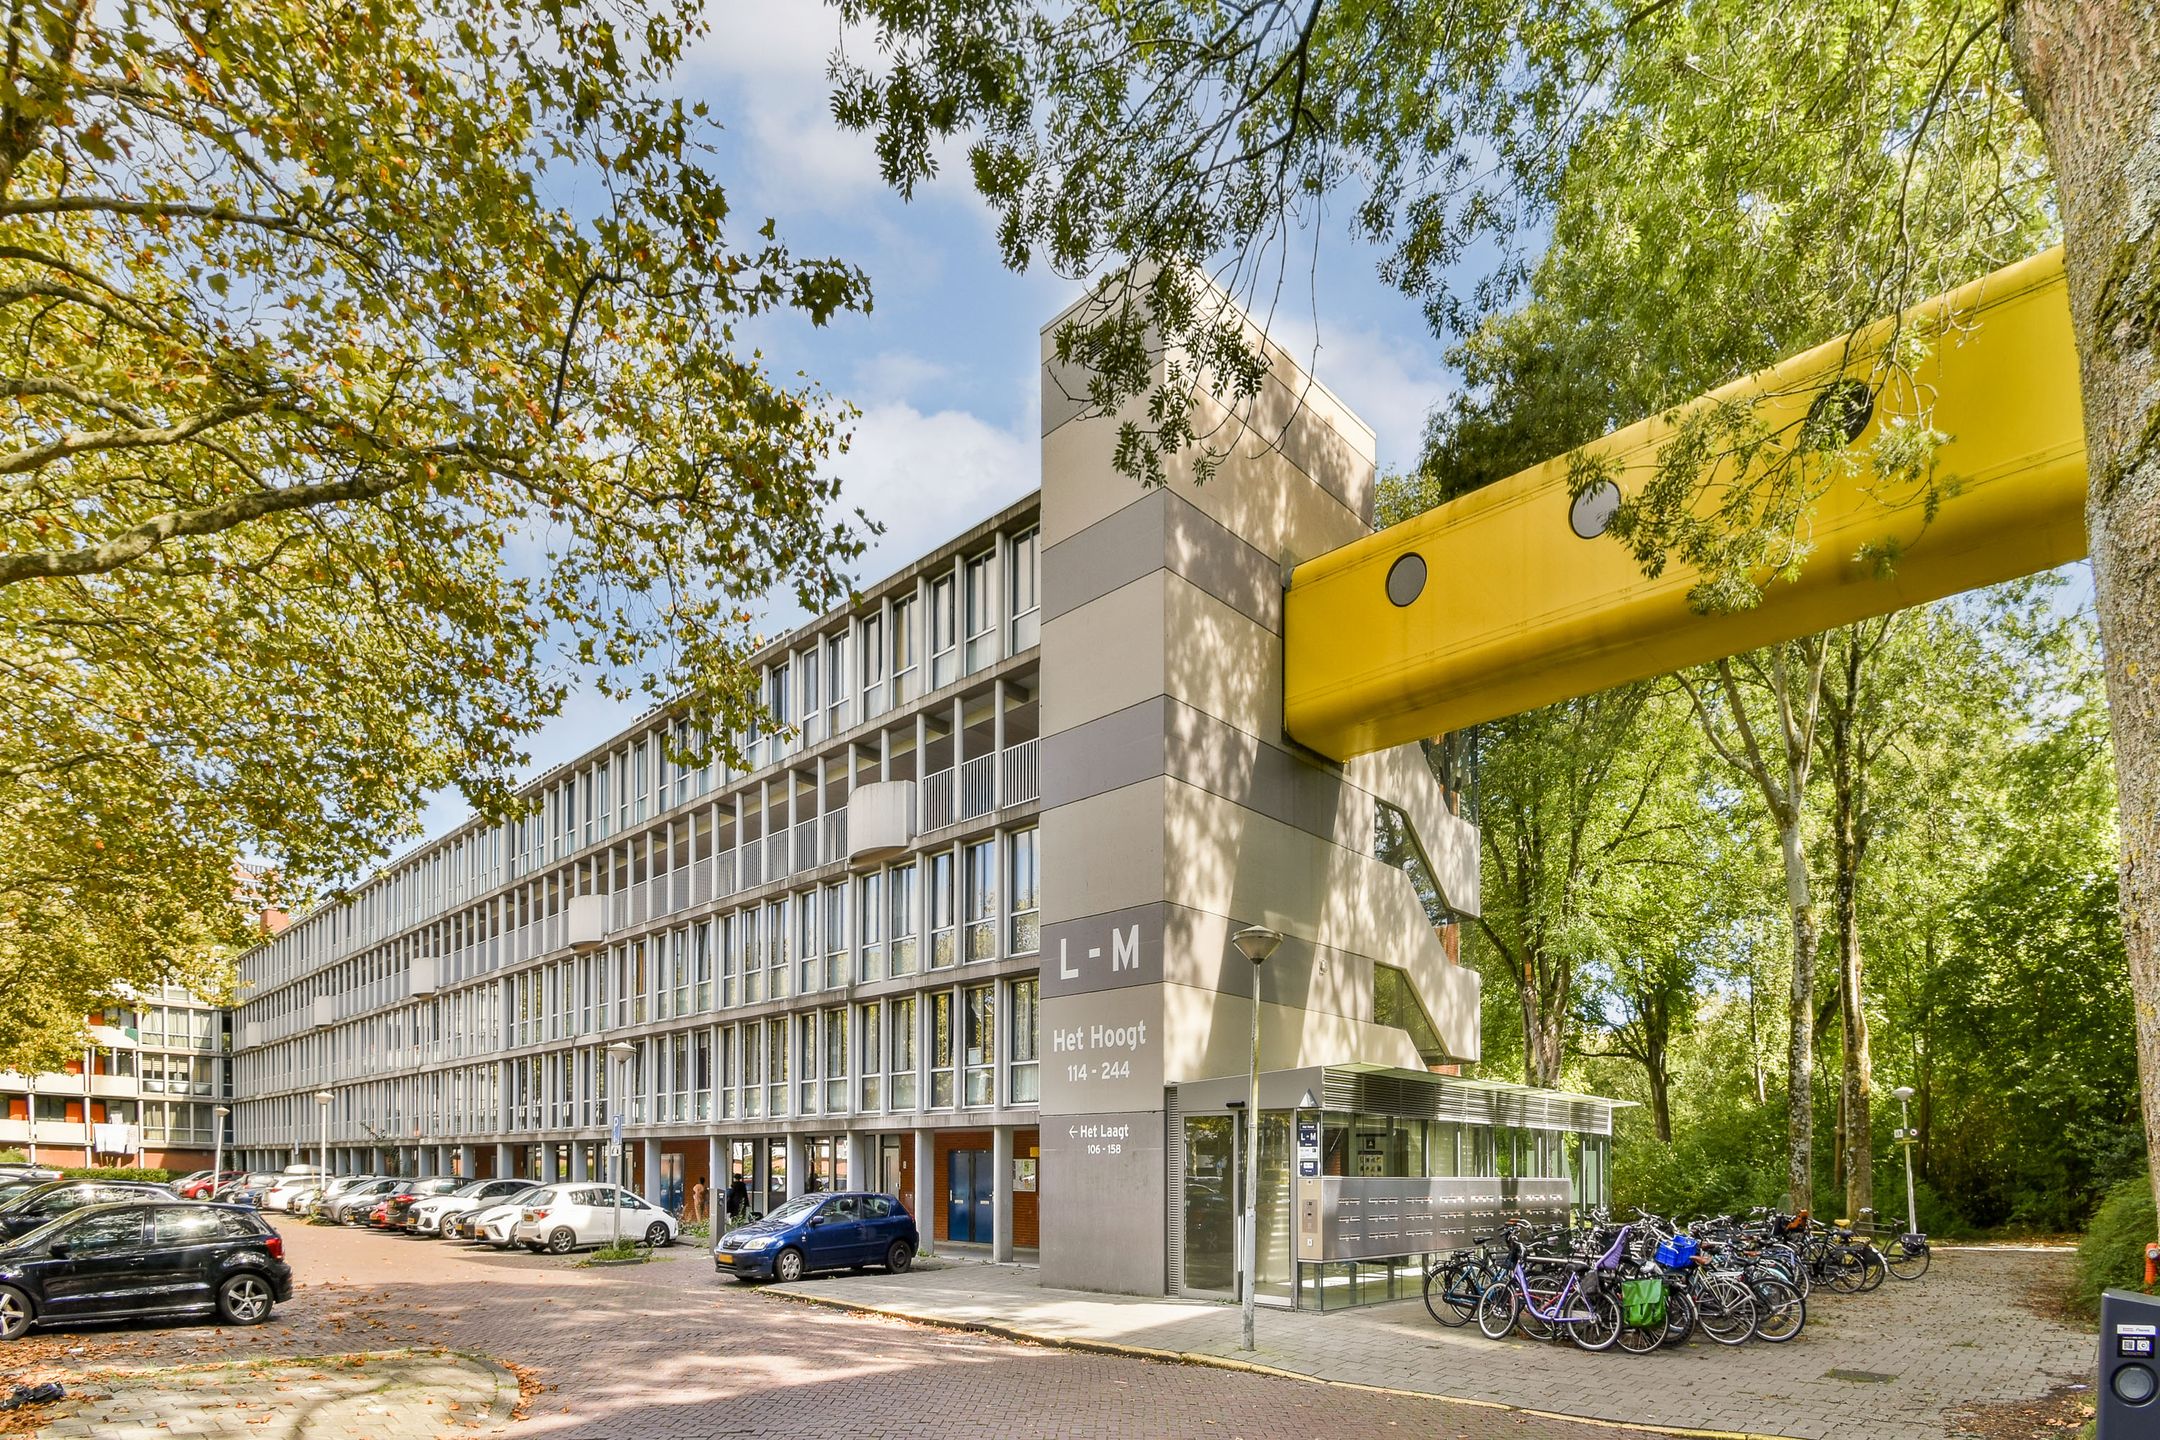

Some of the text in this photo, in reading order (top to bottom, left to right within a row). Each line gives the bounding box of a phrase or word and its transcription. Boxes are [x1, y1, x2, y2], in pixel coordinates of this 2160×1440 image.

[1060, 924, 1140, 981] L - M
[1053, 1019, 1147, 1053] Het Hoogt
[1067, 1063, 1088, 1082] 114
[1101, 1060, 1130, 1080] 244
[1080, 1123, 1129, 1140] Het Laagt
[1300, 1132, 1306, 1141] L
[1087, 1144, 1101, 1155] 106
[1107, 1143, 1122, 1154] 158
